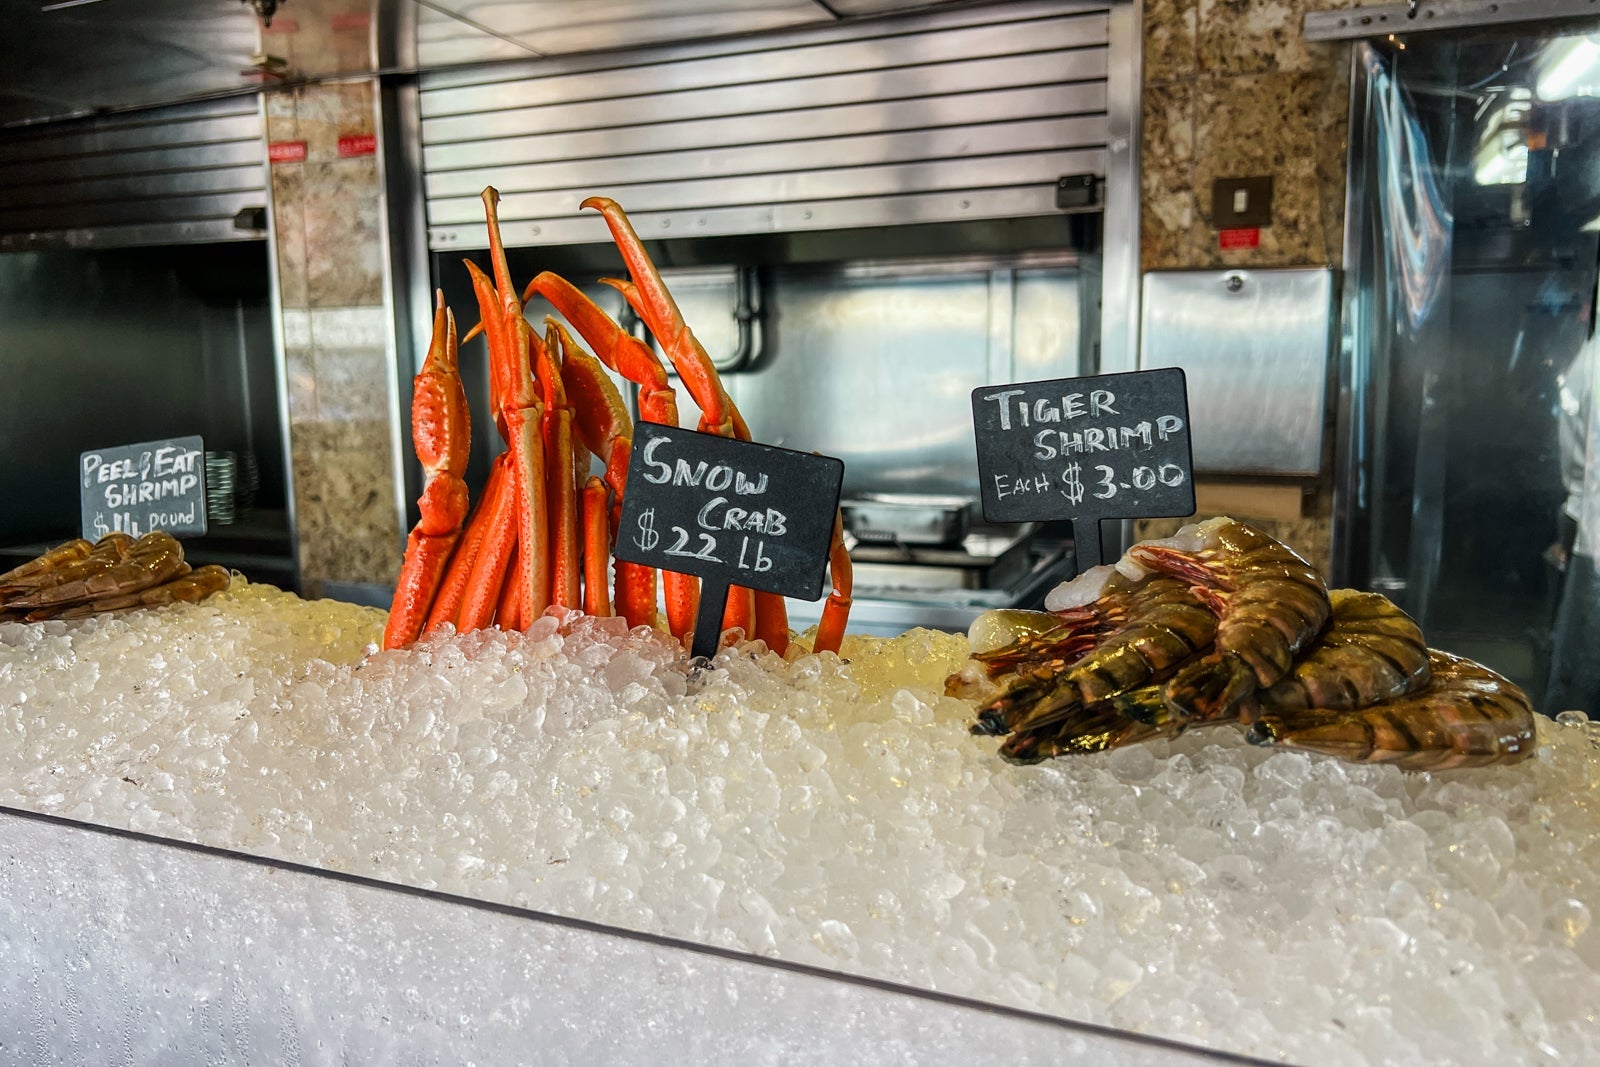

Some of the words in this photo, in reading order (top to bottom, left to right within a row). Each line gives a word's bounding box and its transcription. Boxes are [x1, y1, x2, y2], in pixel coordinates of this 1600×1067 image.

[984, 389, 1121, 431] TIGER
[1033, 415, 1184, 461] SHRIMP
[83, 454, 139, 488] PEEL
[153, 446, 202, 478] EAT
[643, 436, 769, 495] SNOW
[104, 474, 197, 508] SHRIMP
[994, 472, 1050, 501] EACH
[149, 501, 194, 532] pound
[697, 497, 787, 536] CRAB
